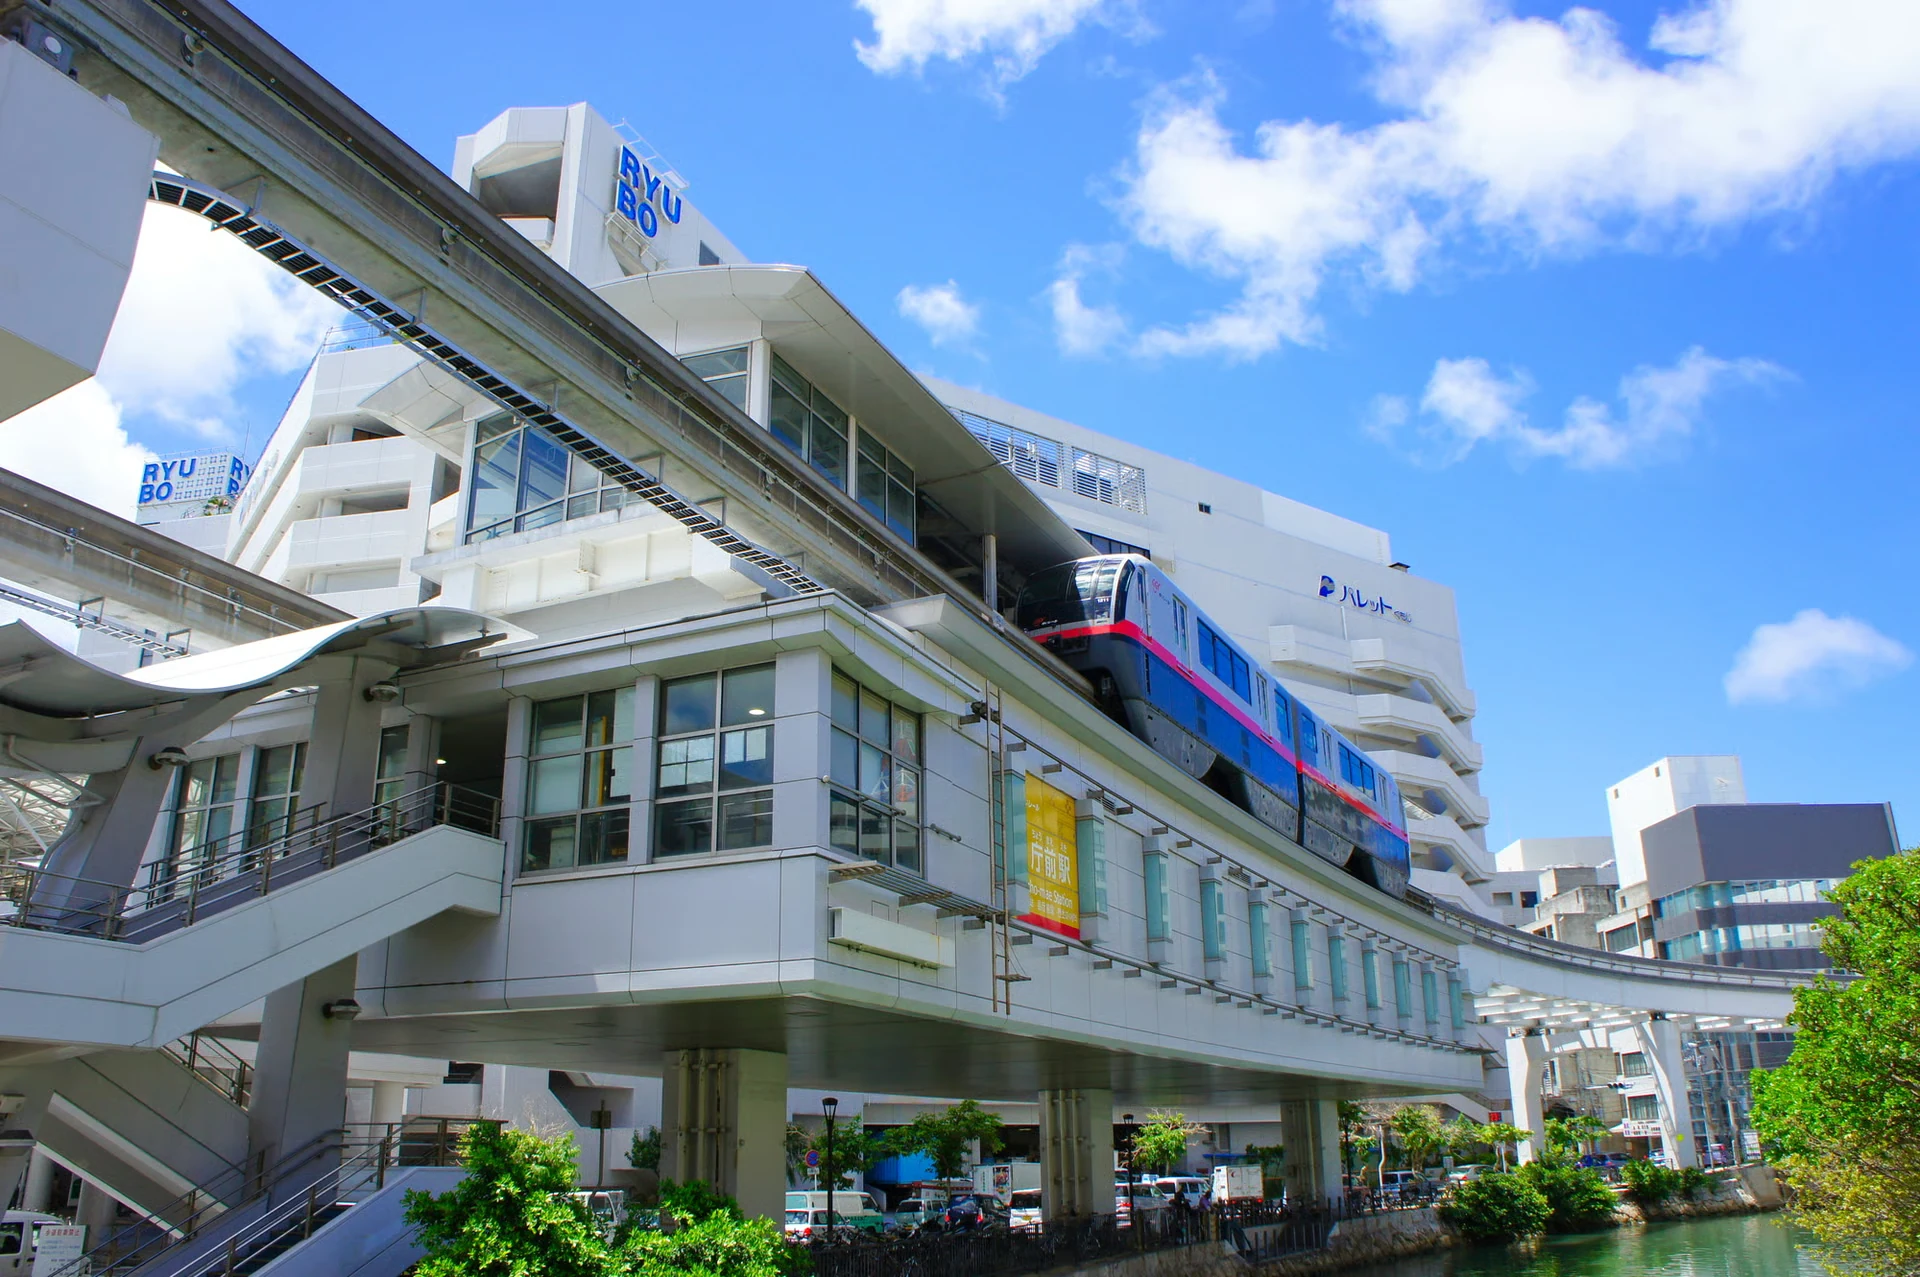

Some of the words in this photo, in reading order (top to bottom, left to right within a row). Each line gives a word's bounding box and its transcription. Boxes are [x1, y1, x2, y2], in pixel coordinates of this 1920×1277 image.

[618, 143, 682, 225] RYU
[615, 179, 658, 238] BO
[142, 458, 197, 483] RYU
[138, 481, 174, 504] BO
[1030, 842, 1072, 885] 庁前駅
[1053, 889, 1073, 910] Station
